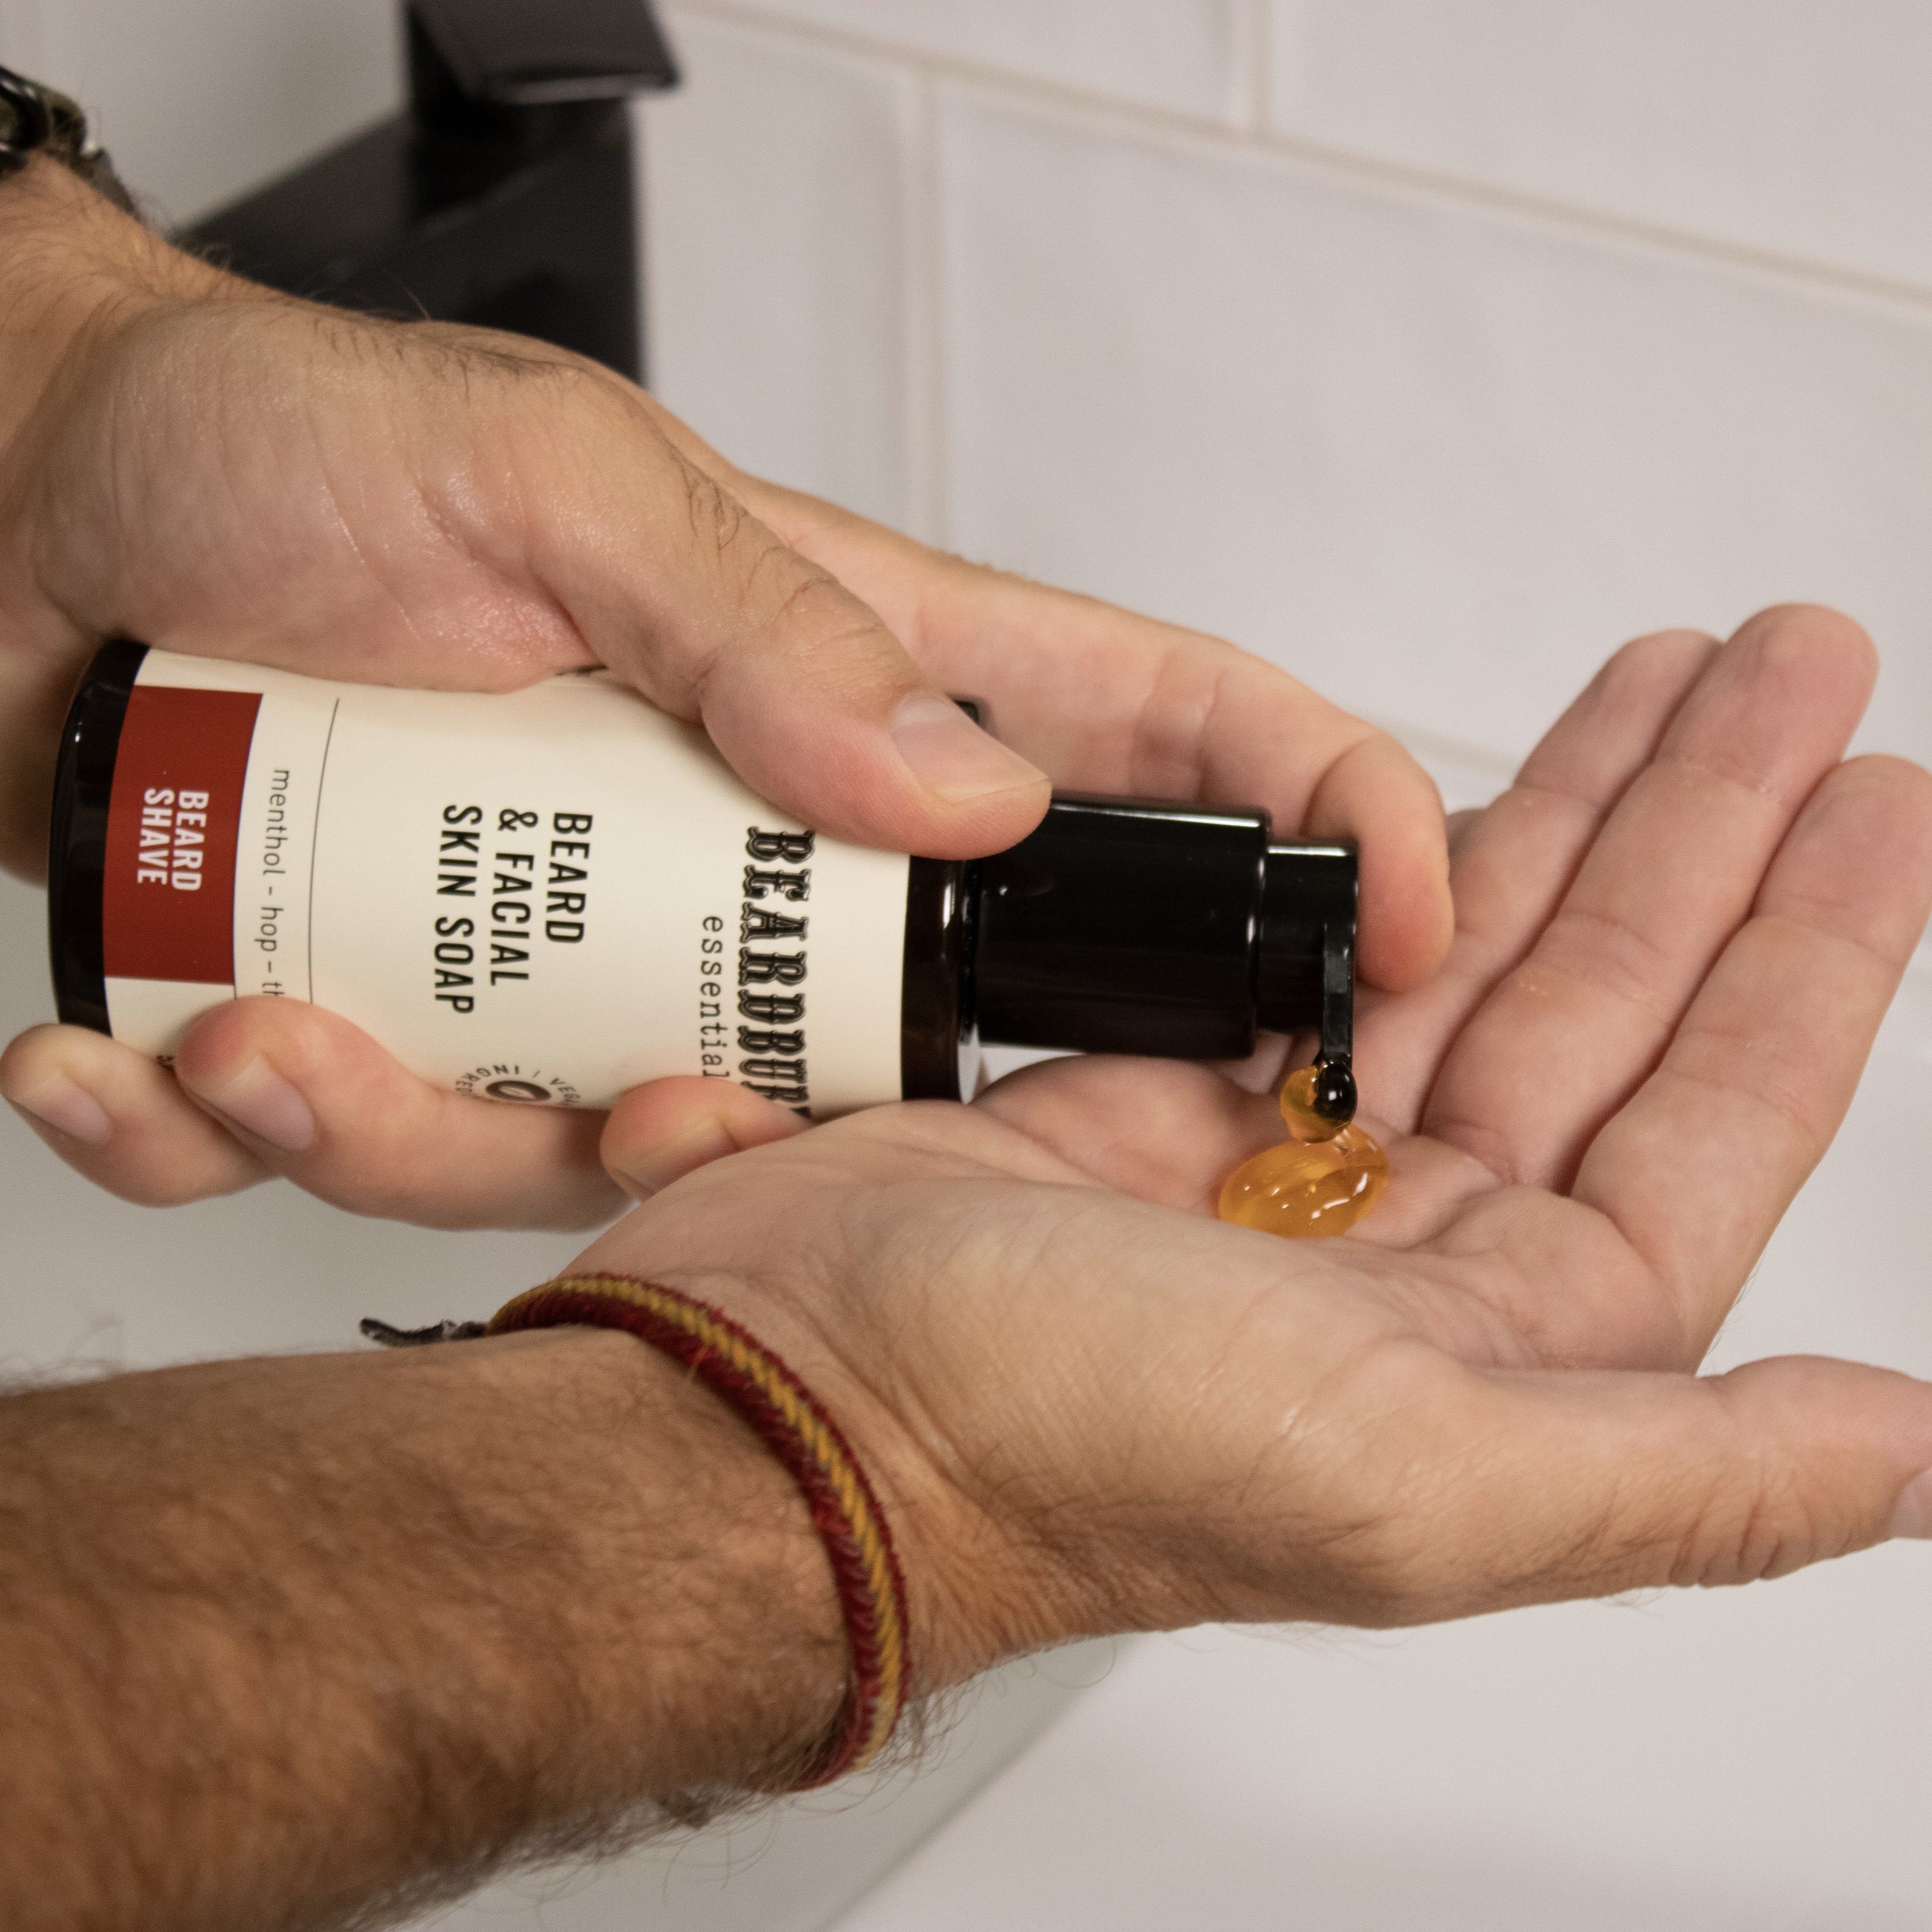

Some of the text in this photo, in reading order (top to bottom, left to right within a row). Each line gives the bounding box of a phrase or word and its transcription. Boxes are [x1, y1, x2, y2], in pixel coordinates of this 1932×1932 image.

[137, 788, 176, 885] SHAVE
[171, 790, 209, 891] BEARD
[262, 770, 290, 875] menthol
[544, 812, 594, 944] BEARD
[253, 906, 284, 952] hop
[433, 804, 484, 1014] SKIN SOAP
[489, 808, 539, 987] & FACIAL
[699, 916, 731, 1077] essential
[737, 826, 816, 1118] BEARDBUR
